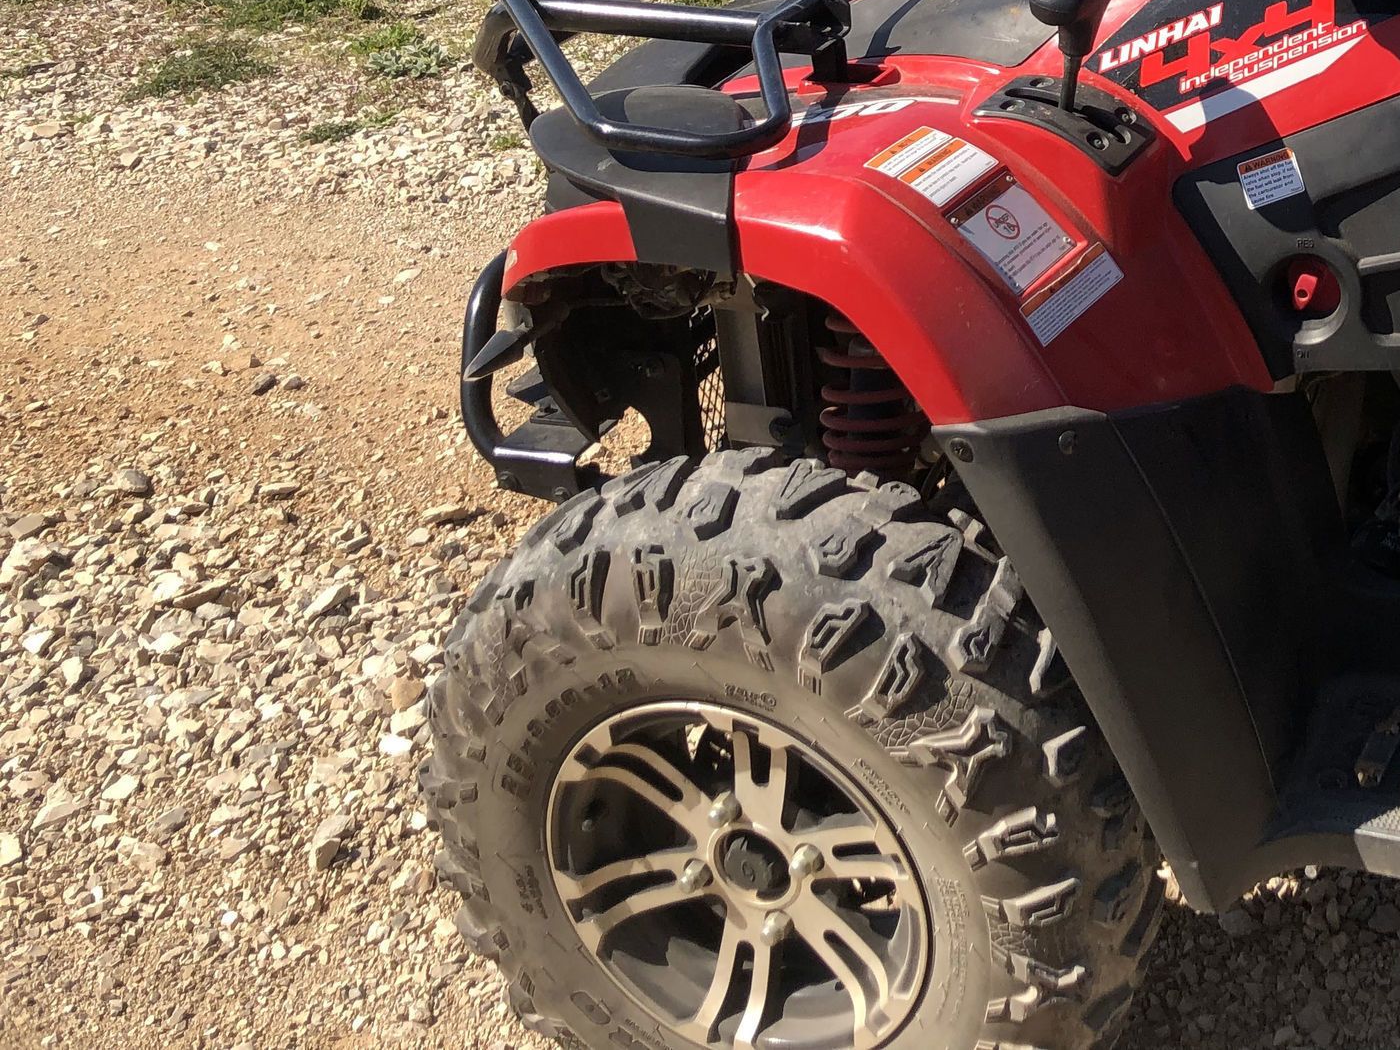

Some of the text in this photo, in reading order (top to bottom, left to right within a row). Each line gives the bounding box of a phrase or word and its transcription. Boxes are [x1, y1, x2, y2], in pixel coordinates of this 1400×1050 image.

[1099, 2, 1224, 73] LINHAI
[1180, 21, 1333, 94] independent
[1228, 19, 1367, 83] suspension
[1252, 152, 1289, 169] WARNING
